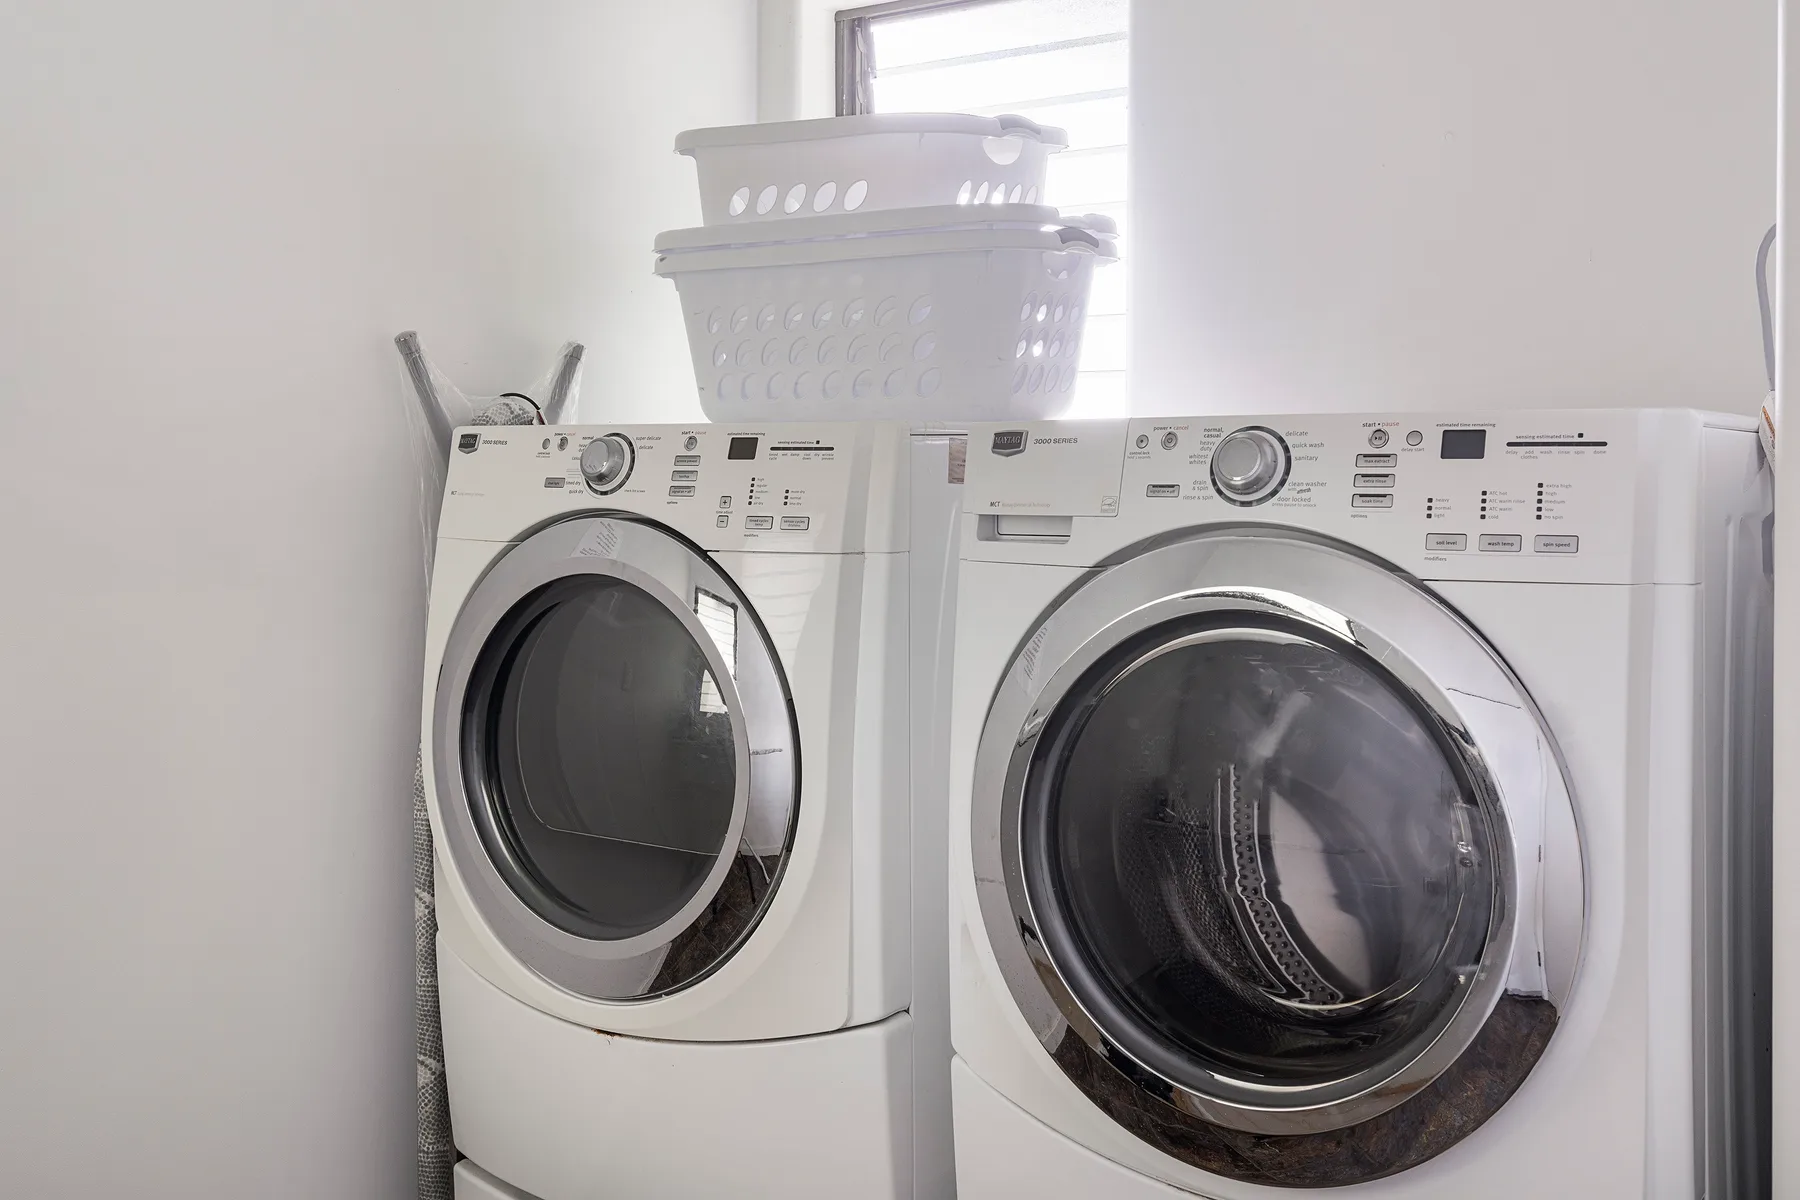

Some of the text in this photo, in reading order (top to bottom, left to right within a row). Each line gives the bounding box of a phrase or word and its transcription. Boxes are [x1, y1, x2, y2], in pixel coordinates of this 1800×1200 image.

[995, 436, 1021, 445] MAYTAG
[1053, 437, 1078, 445] SERIES
[1200, 439, 1215, 447] heavy
[1295, 454, 1318, 462] sanitary
